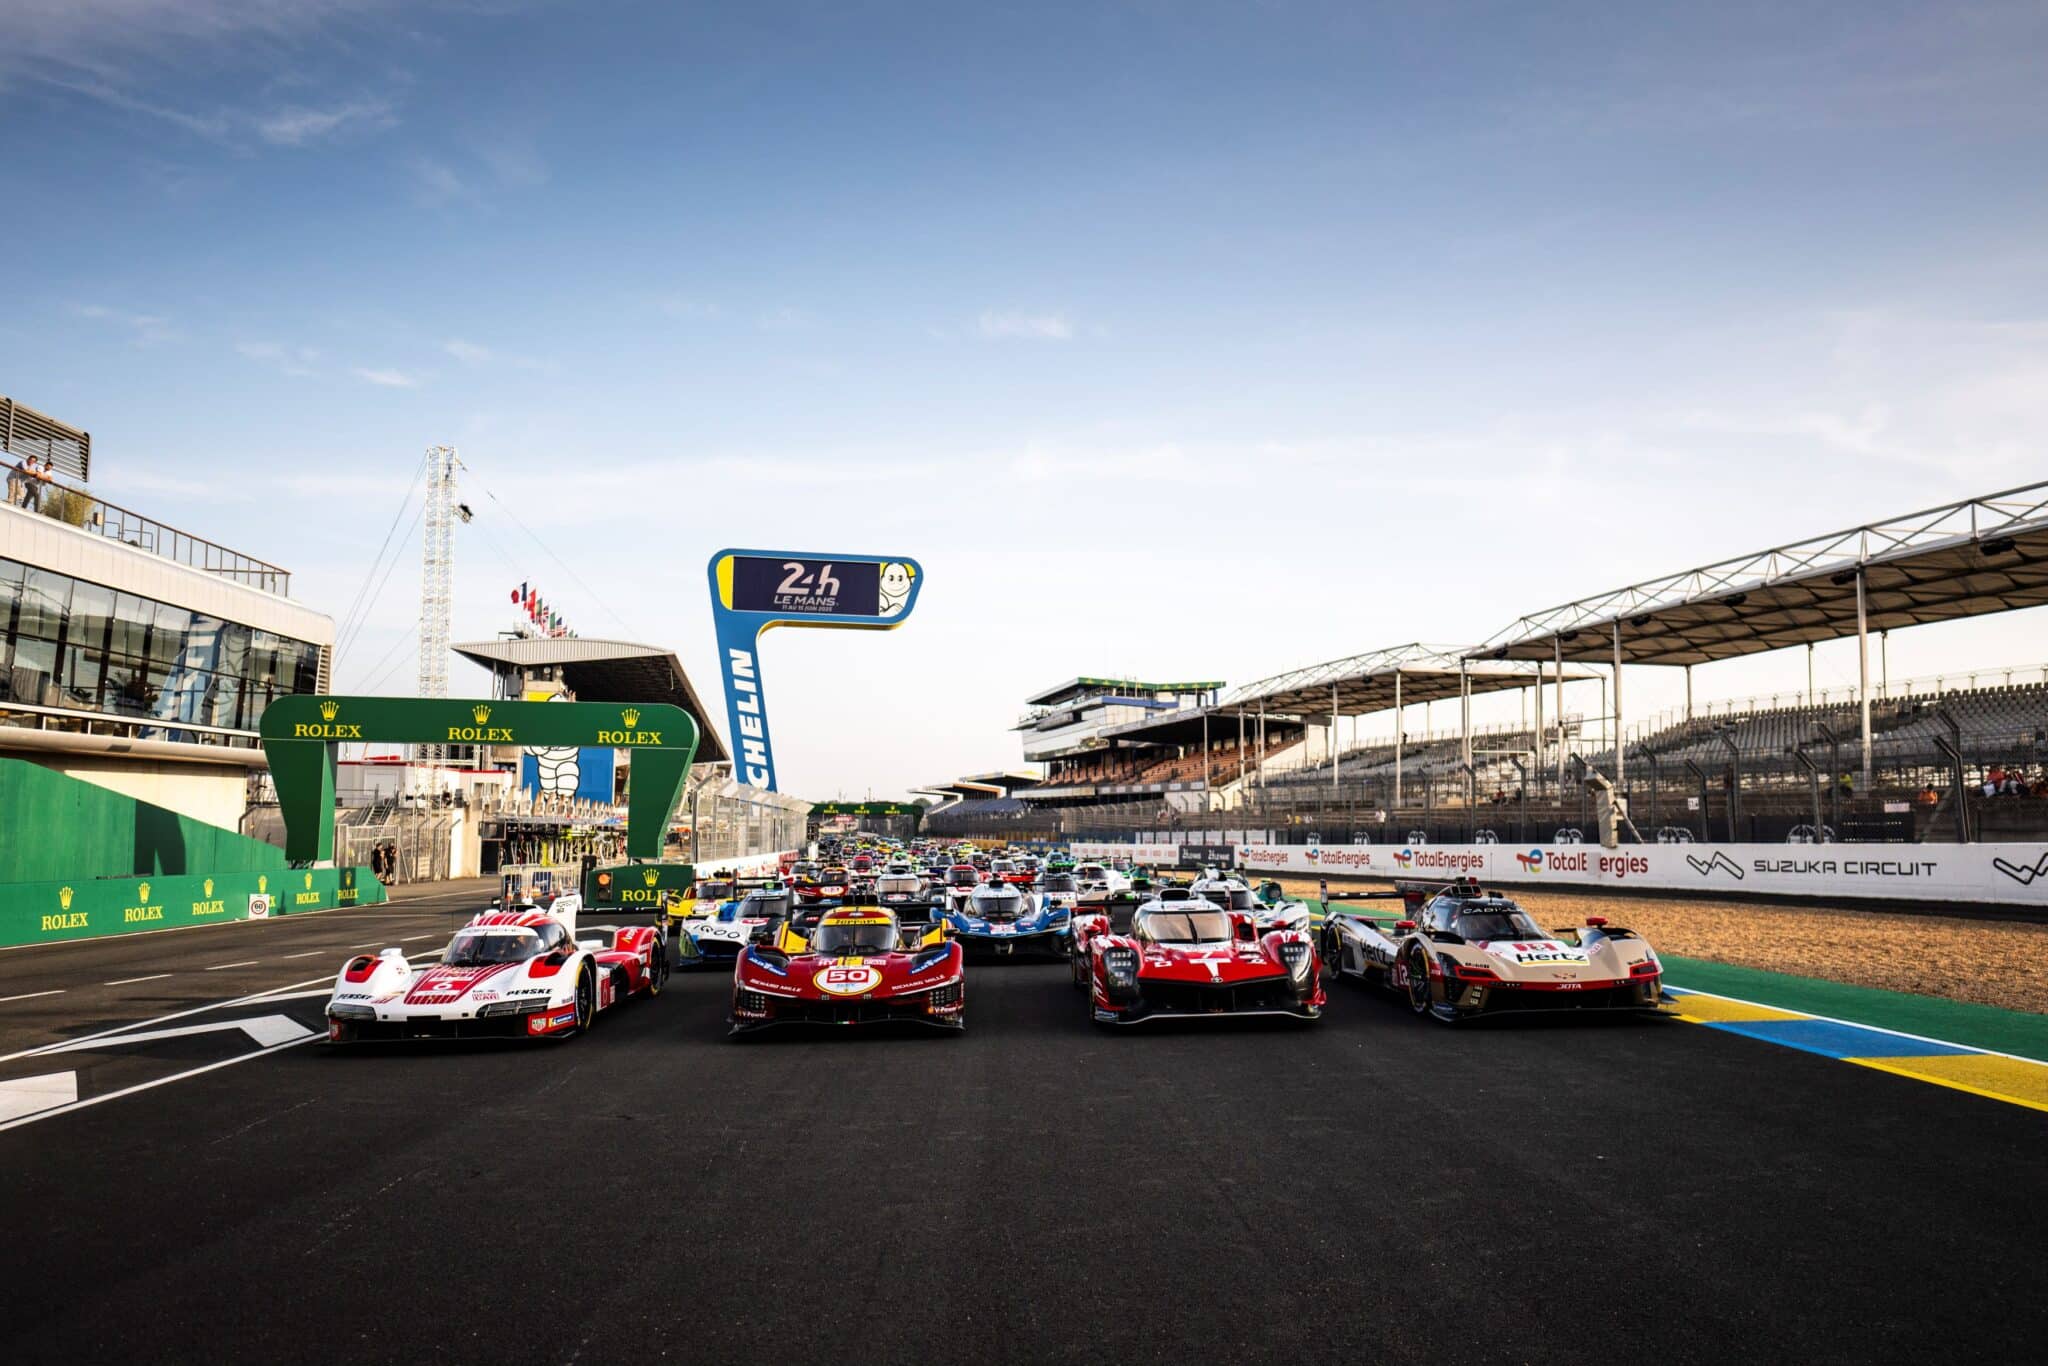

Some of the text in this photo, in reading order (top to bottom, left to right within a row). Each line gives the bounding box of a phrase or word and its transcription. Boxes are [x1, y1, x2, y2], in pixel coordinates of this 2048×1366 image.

[776, 562, 840, 596] 24h
[774, 595, 836, 606] LE MANS
[729, 648, 770, 790] CHELIN
[294, 723, 362, 738] ROLEX
[447, 726, 514, 741] ROLEX
[597, 730, 662, 745] ROLEX
[1251, 849, 1288, 866] TotalEnergies
[1320, 850, 1370, 868] TotalEnergies
[1413, 850, 1484, 876] TotalEnergies
[1545, 851, 1649, 878] TotalEergies
[1753, 859, 1937, 877] SUZUKA CIRCUIT
[296, 892, 320, 905] ROLEX
[337, 888, 359, 900] ROLEX
[124, 905, 163, 922] ROLEX
[192, 900, 225, 915] ROLEX
[41, 912, 89, 931] ROLEX
[1516, 952, 1588, 963] Hertz
[830, 970, 867, 981] 50
[432, 981, 453, 990] 6
[506, 988, 553, 996] PENSKE
